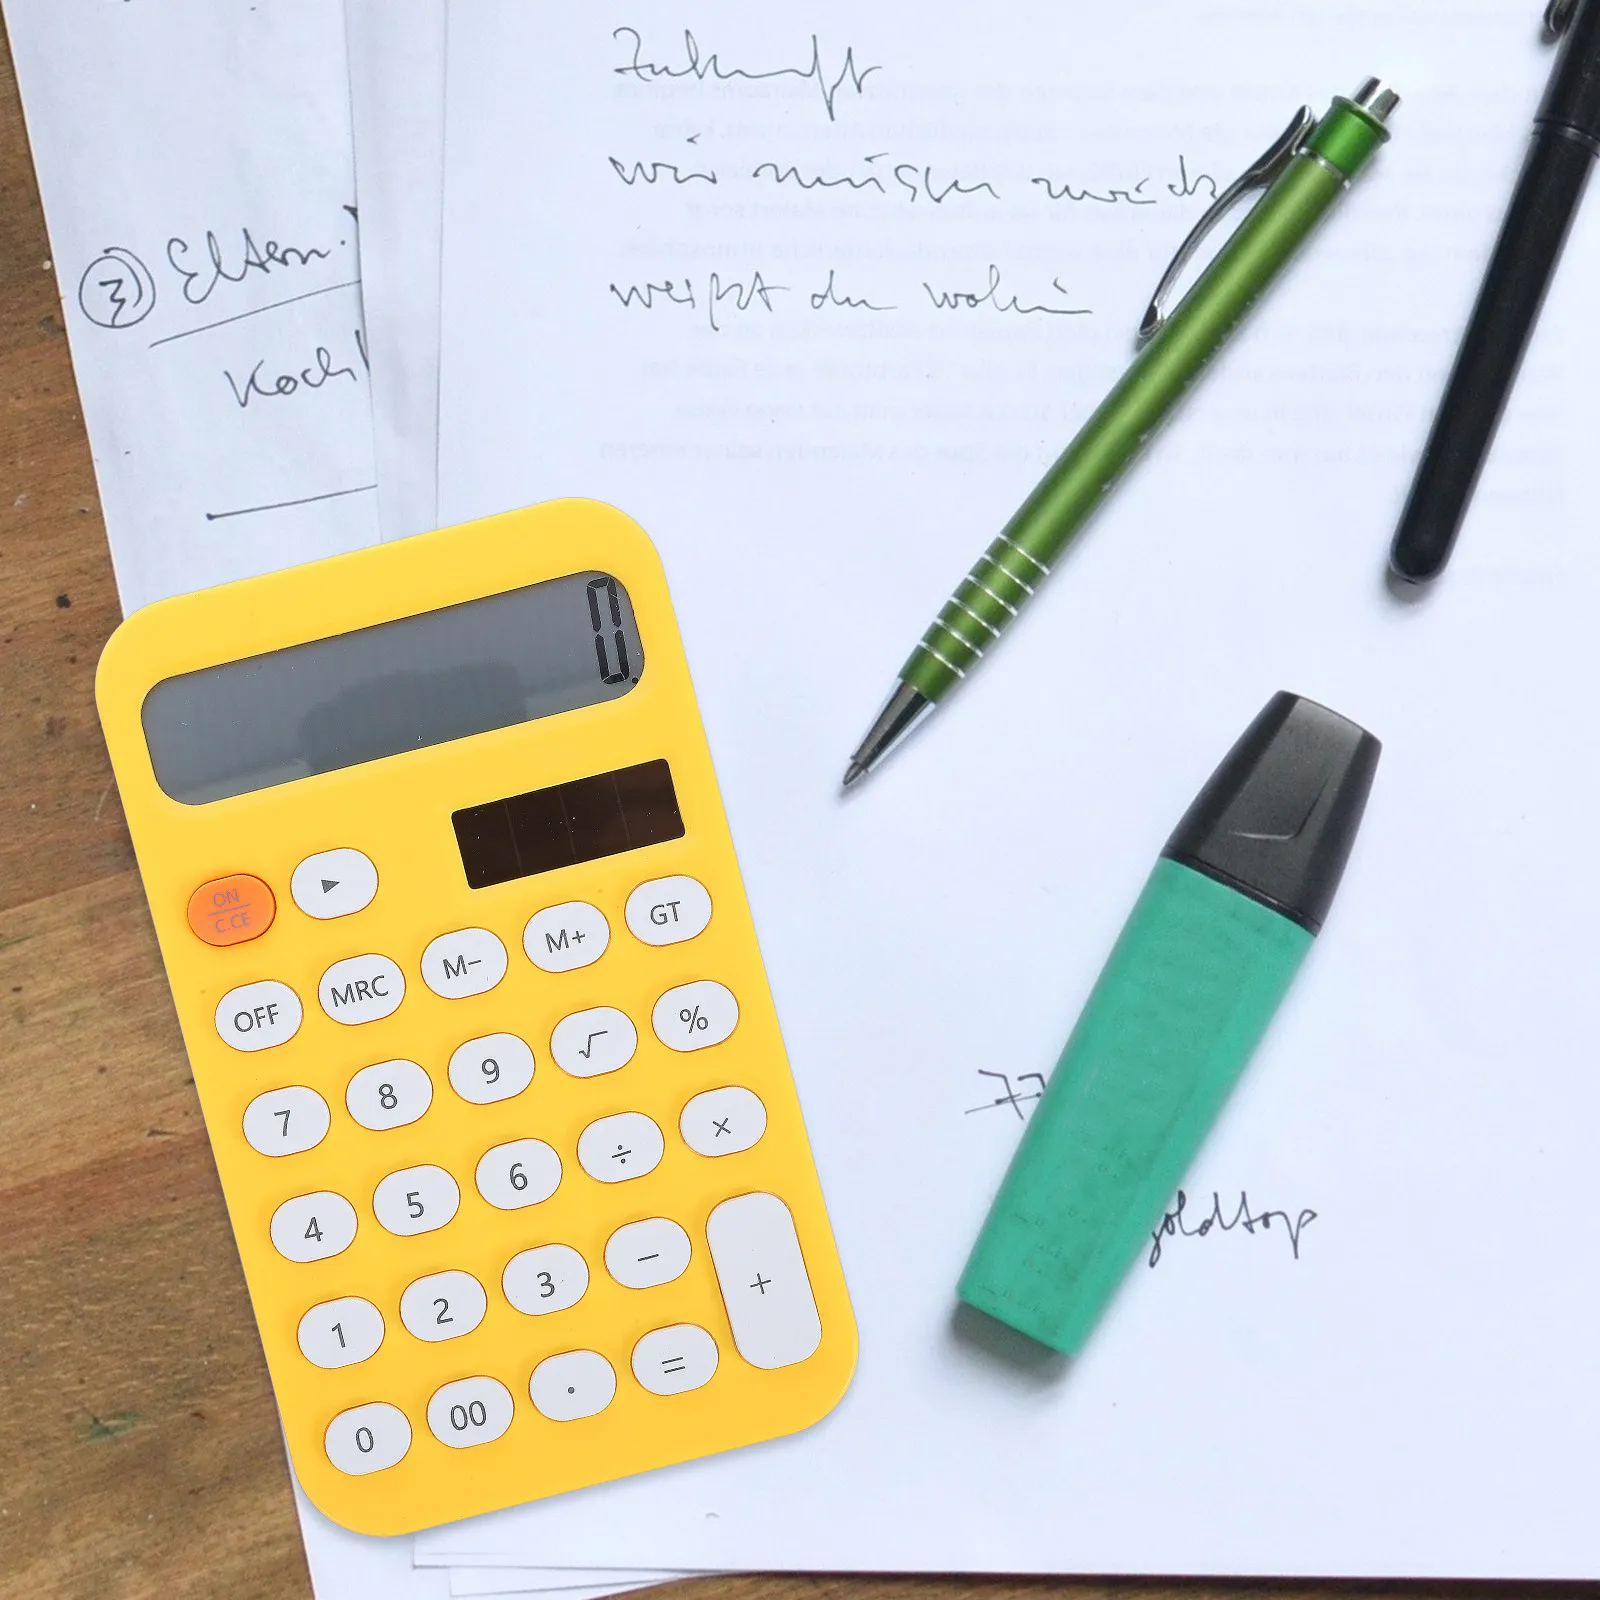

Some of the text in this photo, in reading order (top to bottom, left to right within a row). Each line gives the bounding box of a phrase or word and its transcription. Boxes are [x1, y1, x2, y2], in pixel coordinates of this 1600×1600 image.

[811, 269, 898, 311] du
[212, 888, 240, 908] ON
[649, 900, 681, 926] GT
[545, 928, 586, 954] M+
[330, 974, 389, 1008] MRC
[233, 1003, 279, 1033] OFF
[481, 1058, 500, 1085] 9
[378, 1083, 398, 1110] 8
[273, 1109, 291, 1137] 7
[509, 1162, 528, 1191] 6
[406, 1191, 425, 1219] 5
[304, 1216, 324, 1242] 4
[536, 1271, 556, 1298] 3
[433, 1298, 454, 1325] 2
[331, 1322, 346, 1349] 1
[450, 1400, 487, 1431] 00
[355, 1426, 375, 1454] 0
